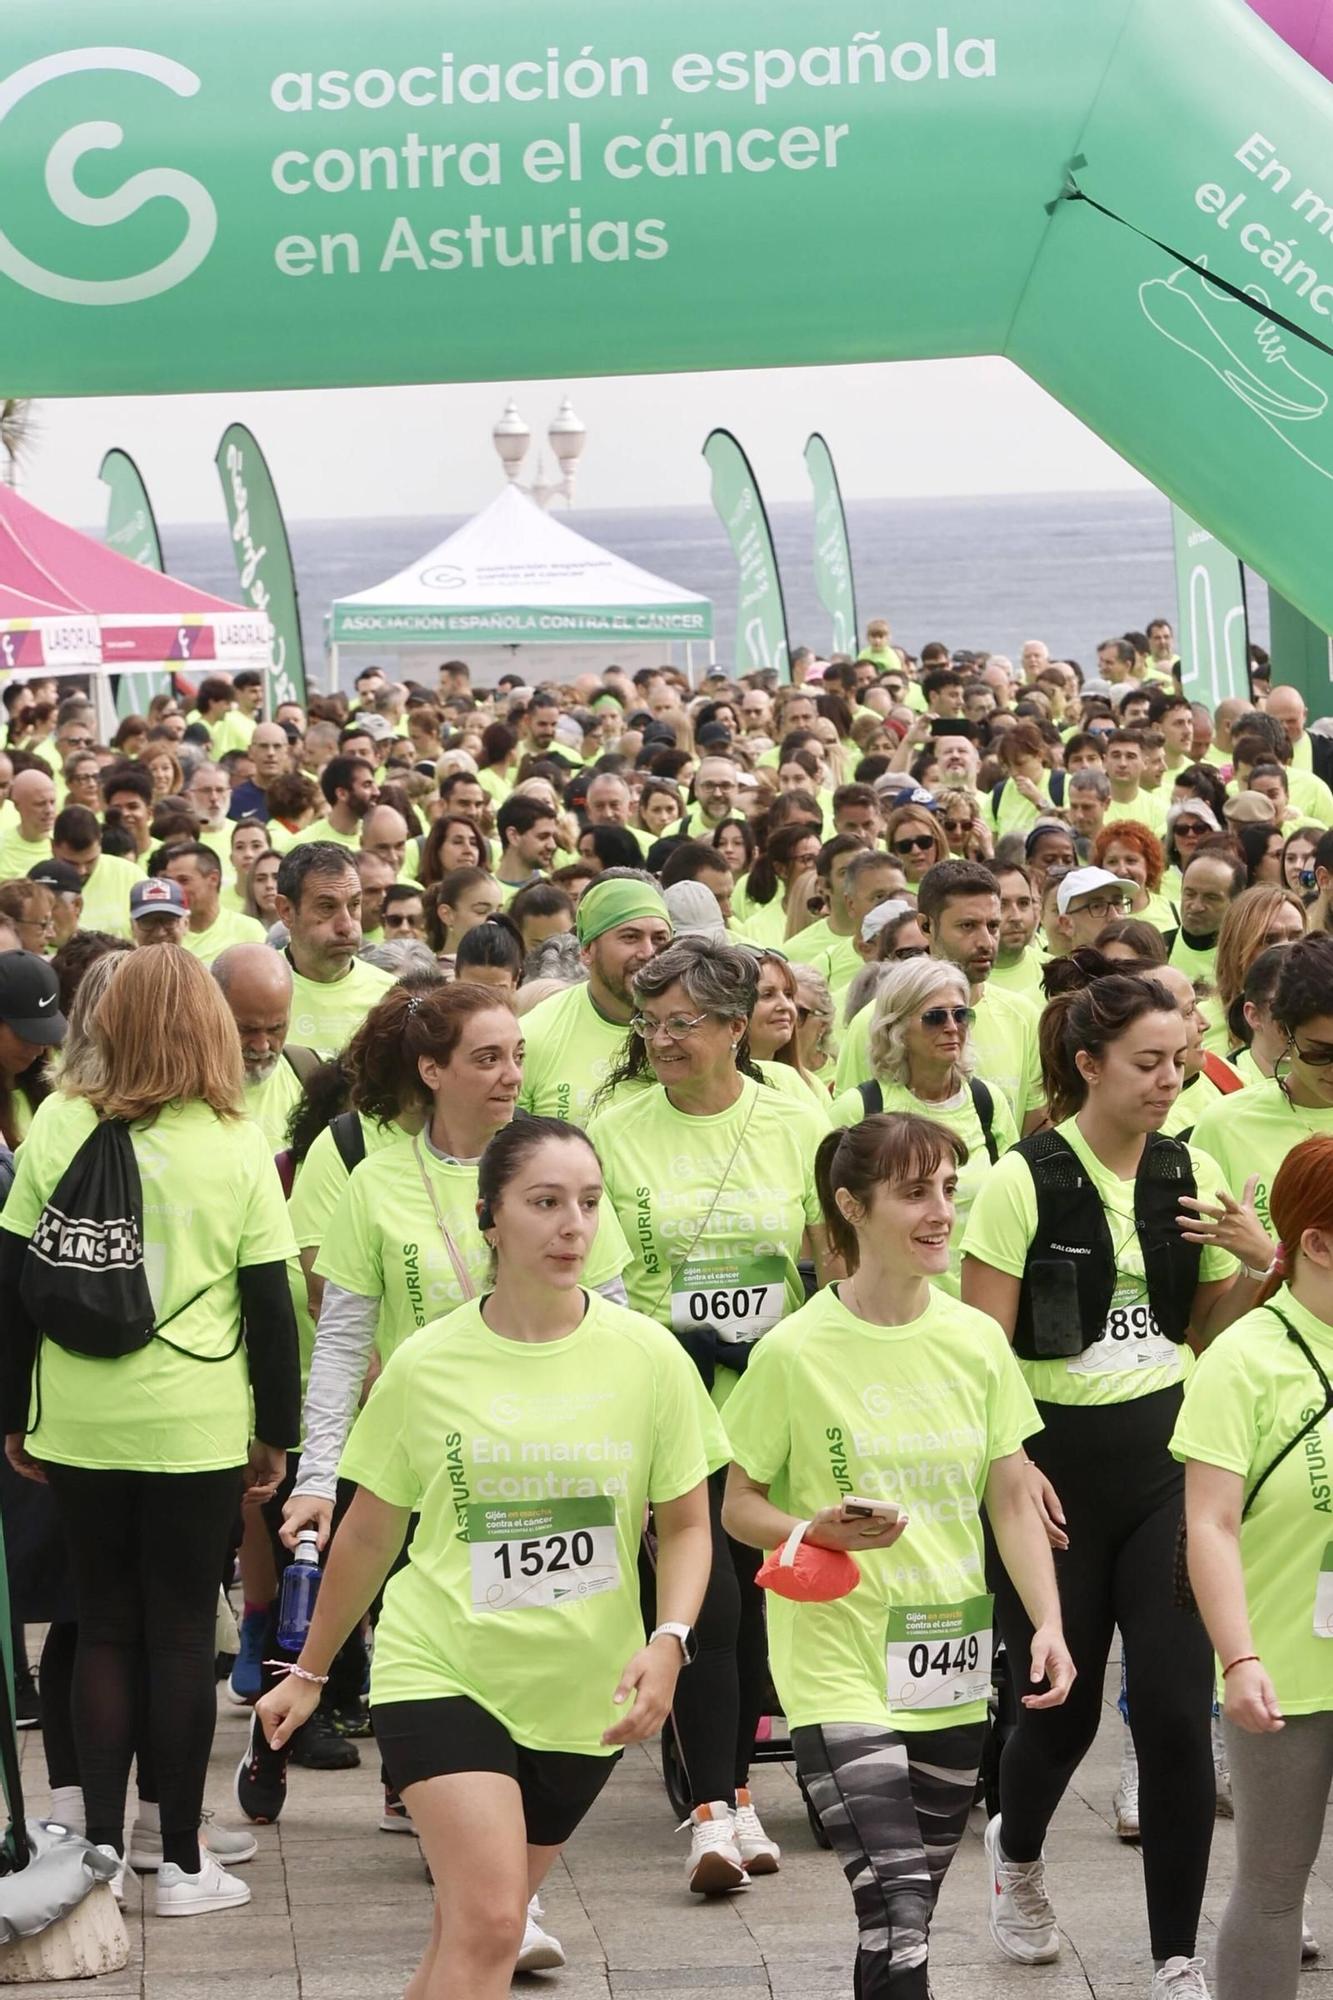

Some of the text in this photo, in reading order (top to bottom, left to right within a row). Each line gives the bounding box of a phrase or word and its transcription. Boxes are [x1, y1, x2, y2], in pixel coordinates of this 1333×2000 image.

[270, 28, 997, 112] asociación española
[272, 117, 849, 194] contra el cáncer
[1234, 131, 1333, 244] En m
[274, 208, 669, 276] en Asturias
[1195, 183, 1333, 318] el cánc
[342, 612, 704, 631] ASOCIACIÓN ESPAÑOLA CONTRA EL CÁNCER
[557, 1083, 570, 1120] RIAS
[659, 1207, 790, 1239] contra el
[1254, 1183, 1272, 1238] RIAS
[636, 1186, 661, 1275] ASTURIAS
[1050, 1242, 1092, 1255] SALOMON
[403, 1242, 426, 1328] STURIAS
[689, 1287, 768, 1321] 0607
[1100, 1306, 1162, 1341] 898
[471, 1434, 633, 1465] En marcha
[826, 1427, 854, 1494] URIAS
[854, 1429, 892, 1458] En
[445, 1431, 471, 1543] ASTURIAS
[475, 1469, 629, 1498] contra el
[858, 1459, 966, 1494] contra
[485, 1510, 507, 1520] Gijón
[486, 1516, 553, 1529] contra el cáncer
[493, 1531, 594, 1579] 1520
[906, 1612, 927, 1622] Gijón
[906, 1622, 932, 1630] contra
[932, 1620, 940, 1629] el
[908, 1635, 979, 1678] 0449
